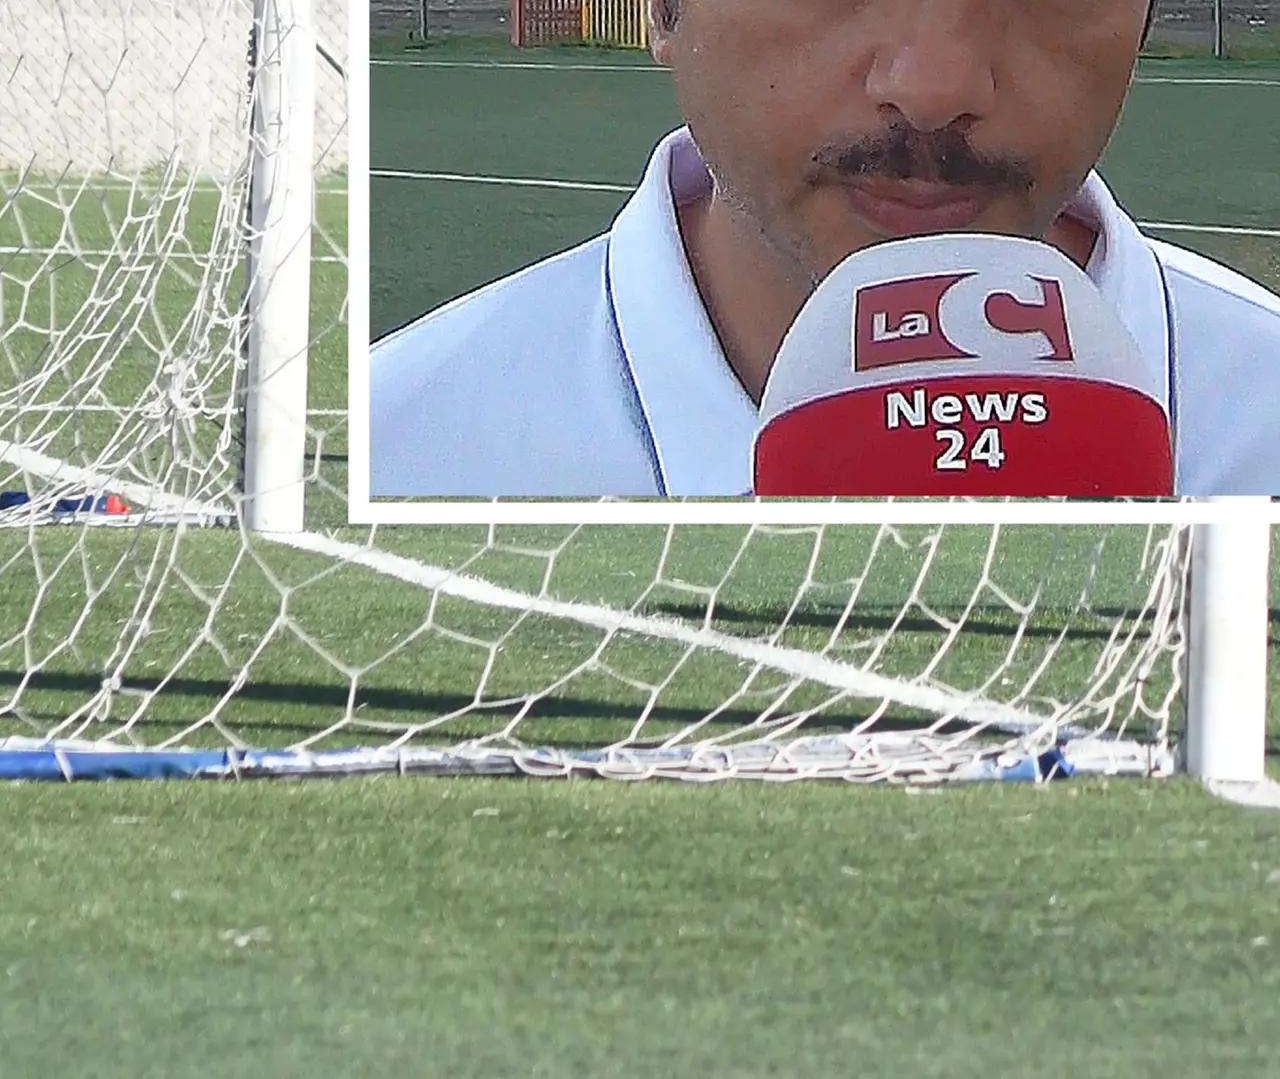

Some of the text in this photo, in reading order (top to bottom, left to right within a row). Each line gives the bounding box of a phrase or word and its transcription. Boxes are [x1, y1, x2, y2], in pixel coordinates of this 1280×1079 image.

[872, 311, 930, 342] La
[886, 388, 1048, 429] News
[935, 428, 1006, 469] 24
